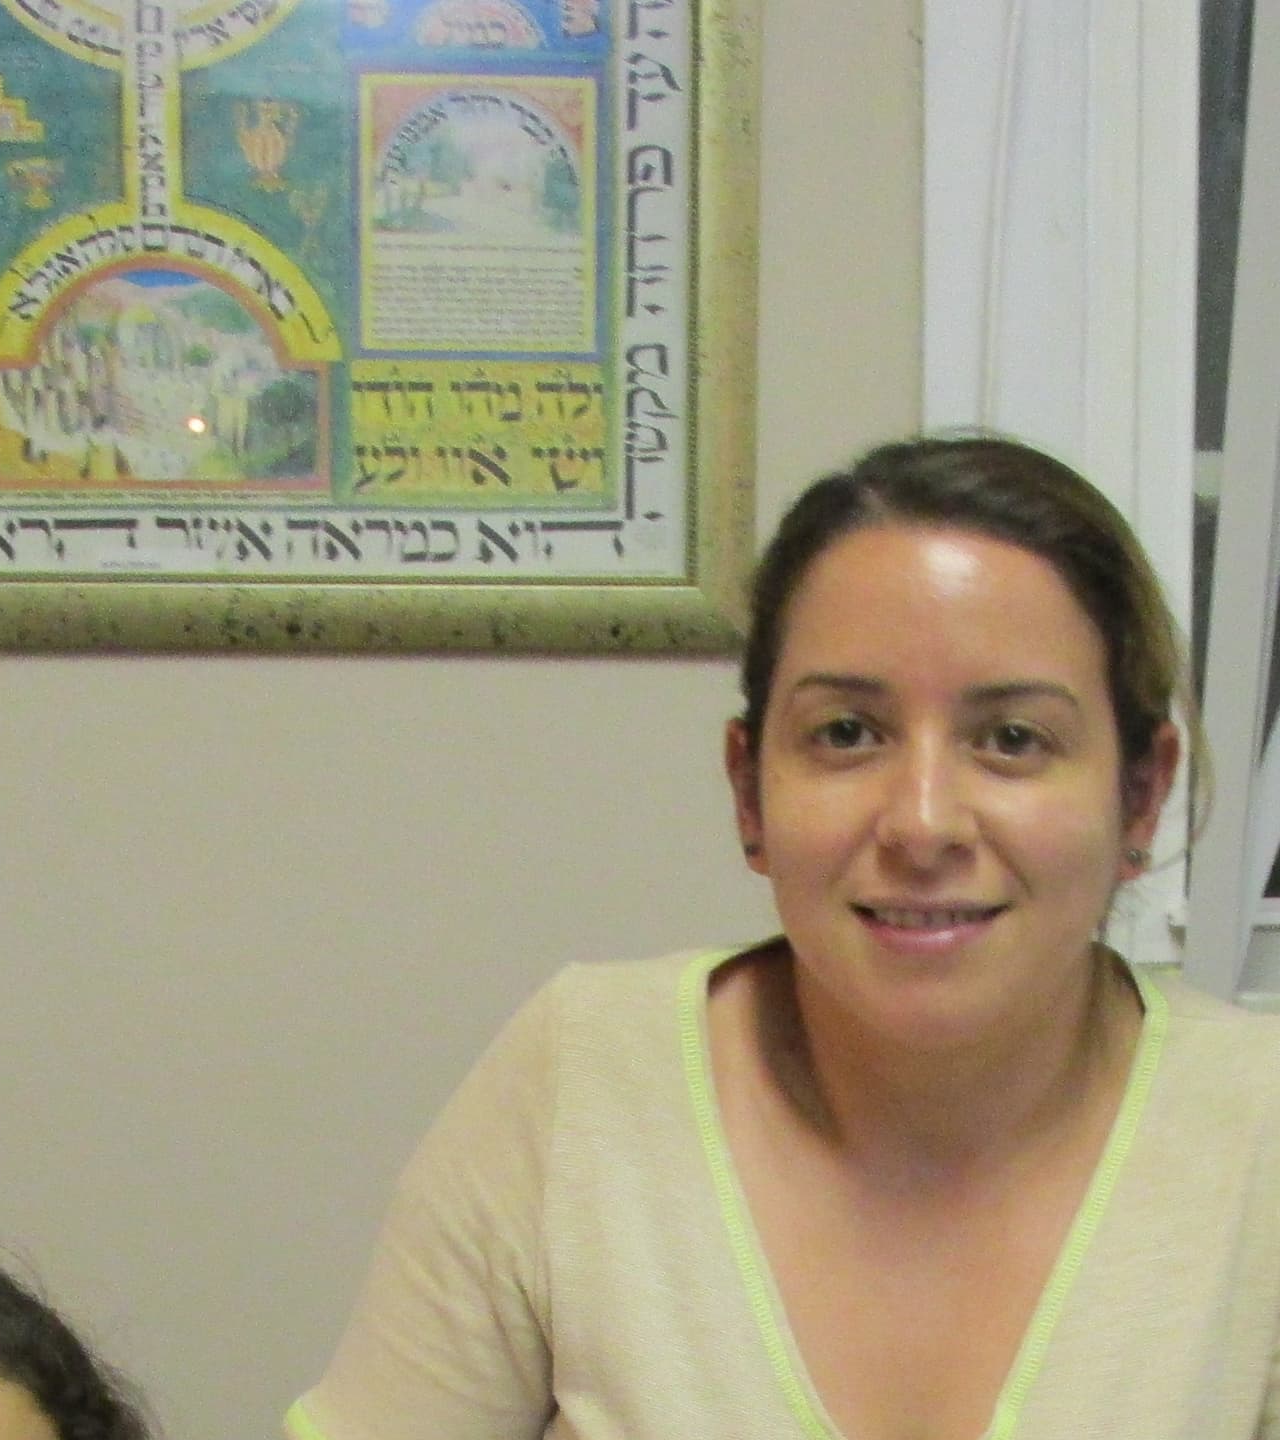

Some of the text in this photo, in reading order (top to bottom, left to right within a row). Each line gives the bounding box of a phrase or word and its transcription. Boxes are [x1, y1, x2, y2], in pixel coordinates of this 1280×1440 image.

[624, 52, 682, 131] עד
[626, 144, 673, 318] פרחה
[625, 343, 681, 520] מקשה
[155, 517, 273, 562] אשר
[286, 517, 460, 563] כמראה
[477, 517, 626, 565] הוא
